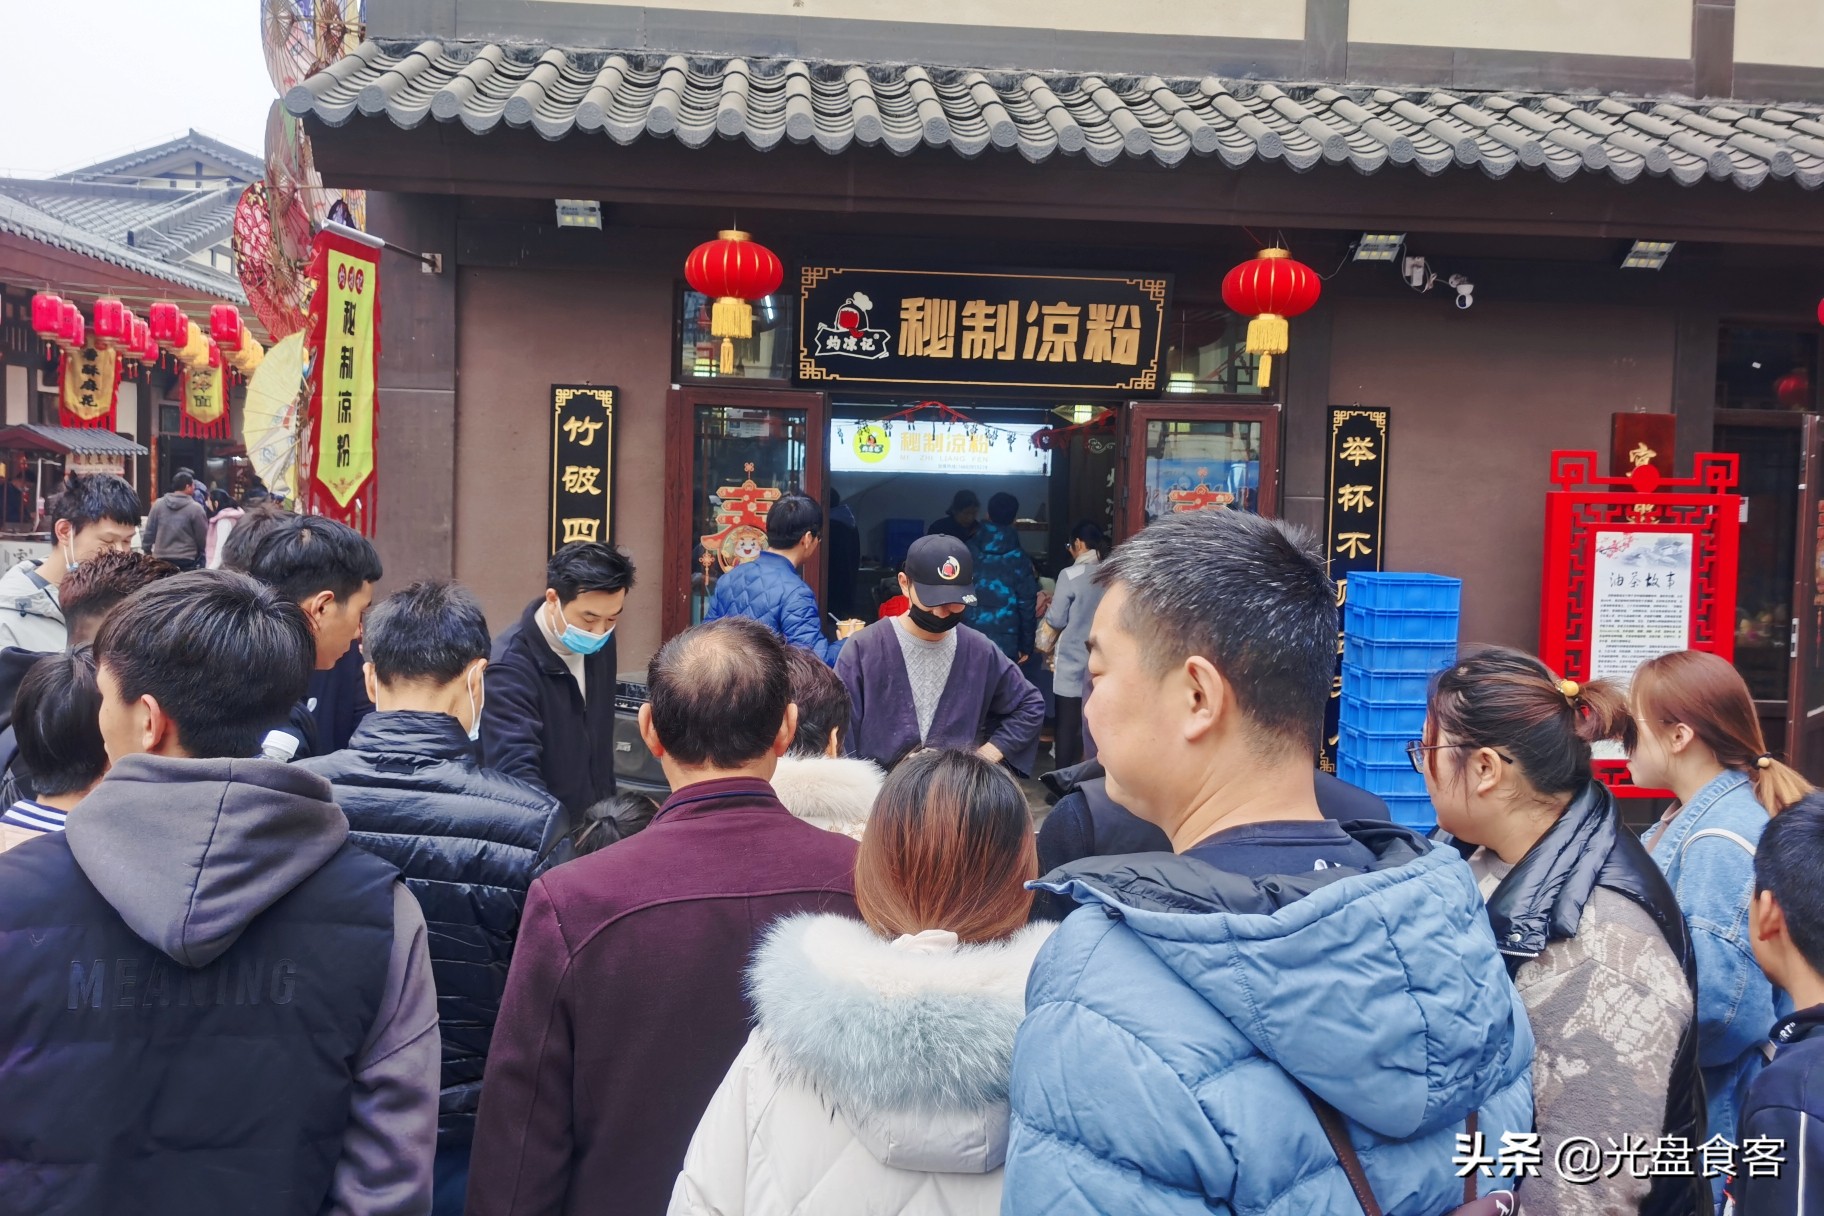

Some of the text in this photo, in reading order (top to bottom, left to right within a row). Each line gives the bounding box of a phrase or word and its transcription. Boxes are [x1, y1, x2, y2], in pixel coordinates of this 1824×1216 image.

[825, 335, 876, 352] 灼凉记
[898, 297, 1142, 366] 秘制凉粉
[336, 299, 358, 468] 秘制凉粉
[900, 431, 989, 454] 秘制凉粉
[561, 415, 604, 544] 竹破四
[1609, 570, 1676, 590] 油茶故事
[67, 958, 299, 1011] MEANING
[1780, 1021, 1796, 1041] RT"
